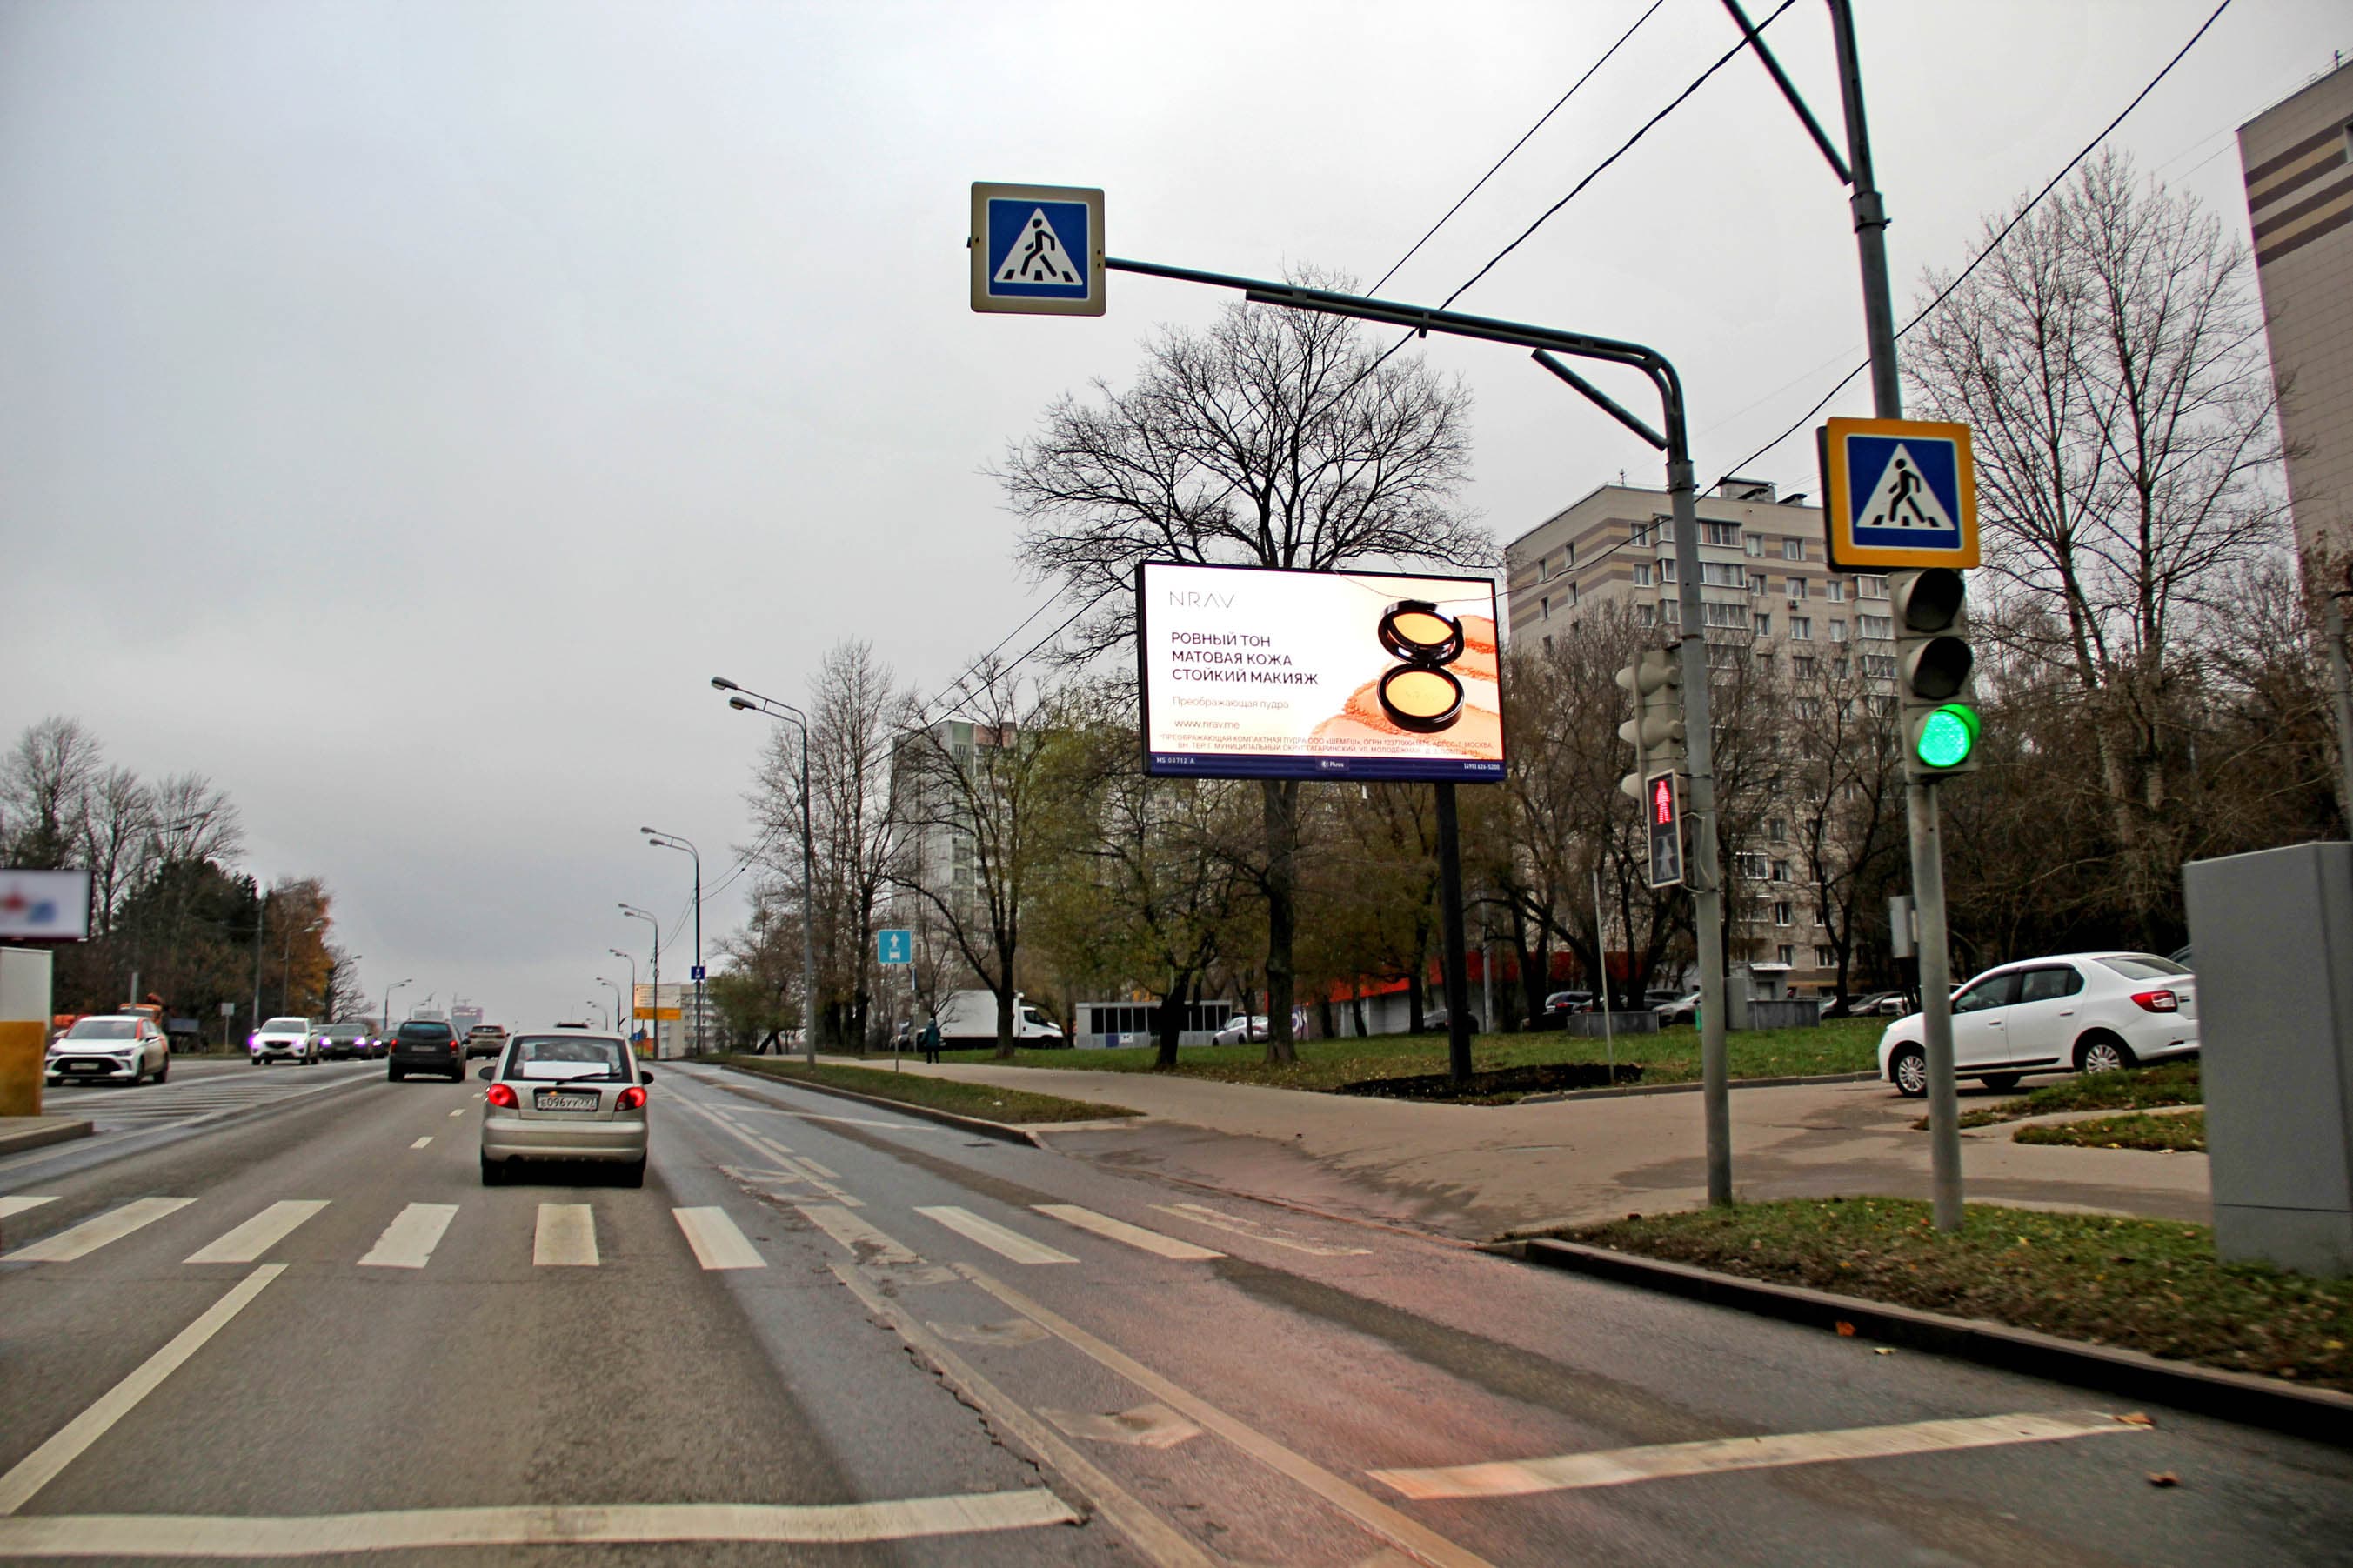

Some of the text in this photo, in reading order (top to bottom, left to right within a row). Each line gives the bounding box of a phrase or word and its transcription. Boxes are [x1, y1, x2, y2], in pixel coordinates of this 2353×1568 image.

[1169, 591, 1235, 609] NRAV
[1171, 631, 1271, 647] РОВНЫЙ ТОН
[1172, 651, 1293, 666] МАТОВАЯ КОЖА
[1172, 667, 1319, 685] СТОЙКИЙ МАКИЯЖ
[1173, 696, 1289, 711] Преображающая пудра
[1174, 720, 1240, 730] www.nrav.me
[1233, 736, 1282, 744] КОМПАКТНАЯ
